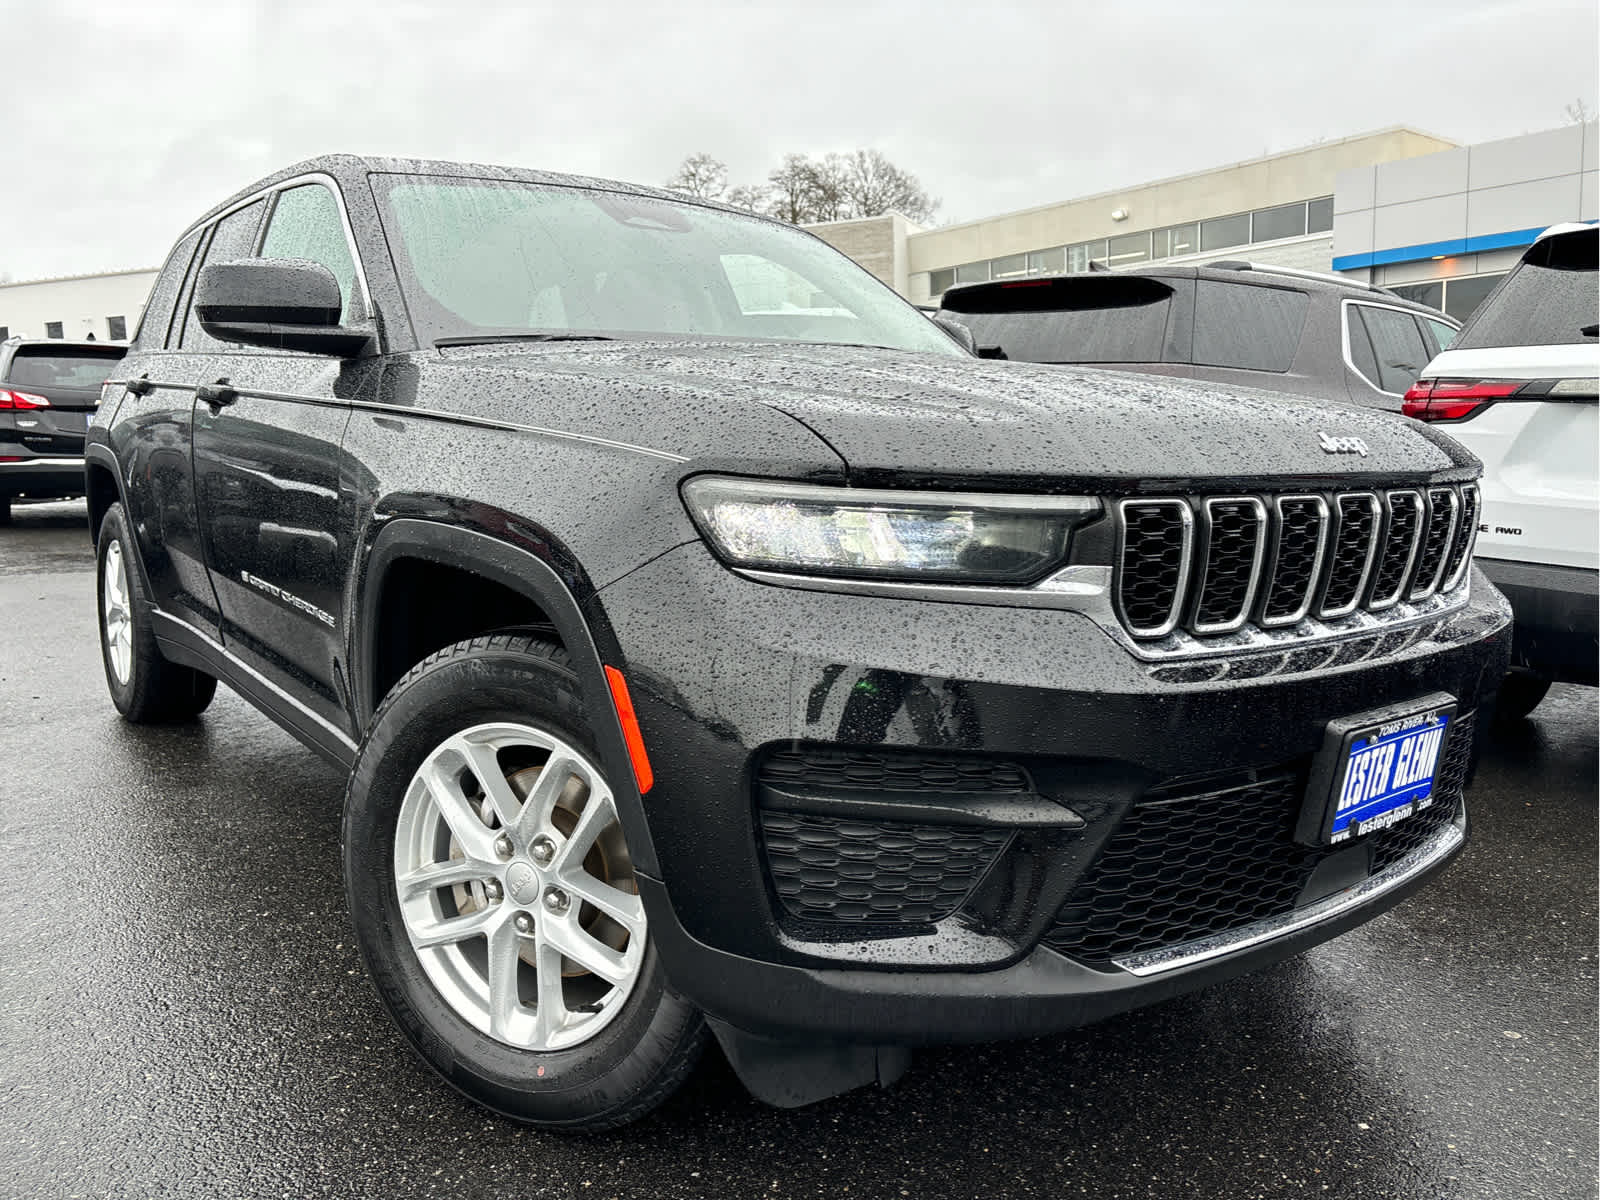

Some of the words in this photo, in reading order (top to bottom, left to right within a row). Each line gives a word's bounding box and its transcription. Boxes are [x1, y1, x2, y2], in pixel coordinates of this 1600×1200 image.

[1318, 431, 1369, 457] Jeep
[1495, 526, 1522, 535] AWD
[1337, 743, 1396, 812] LESTER
[1392, 727, 1444, 790] GLENN
